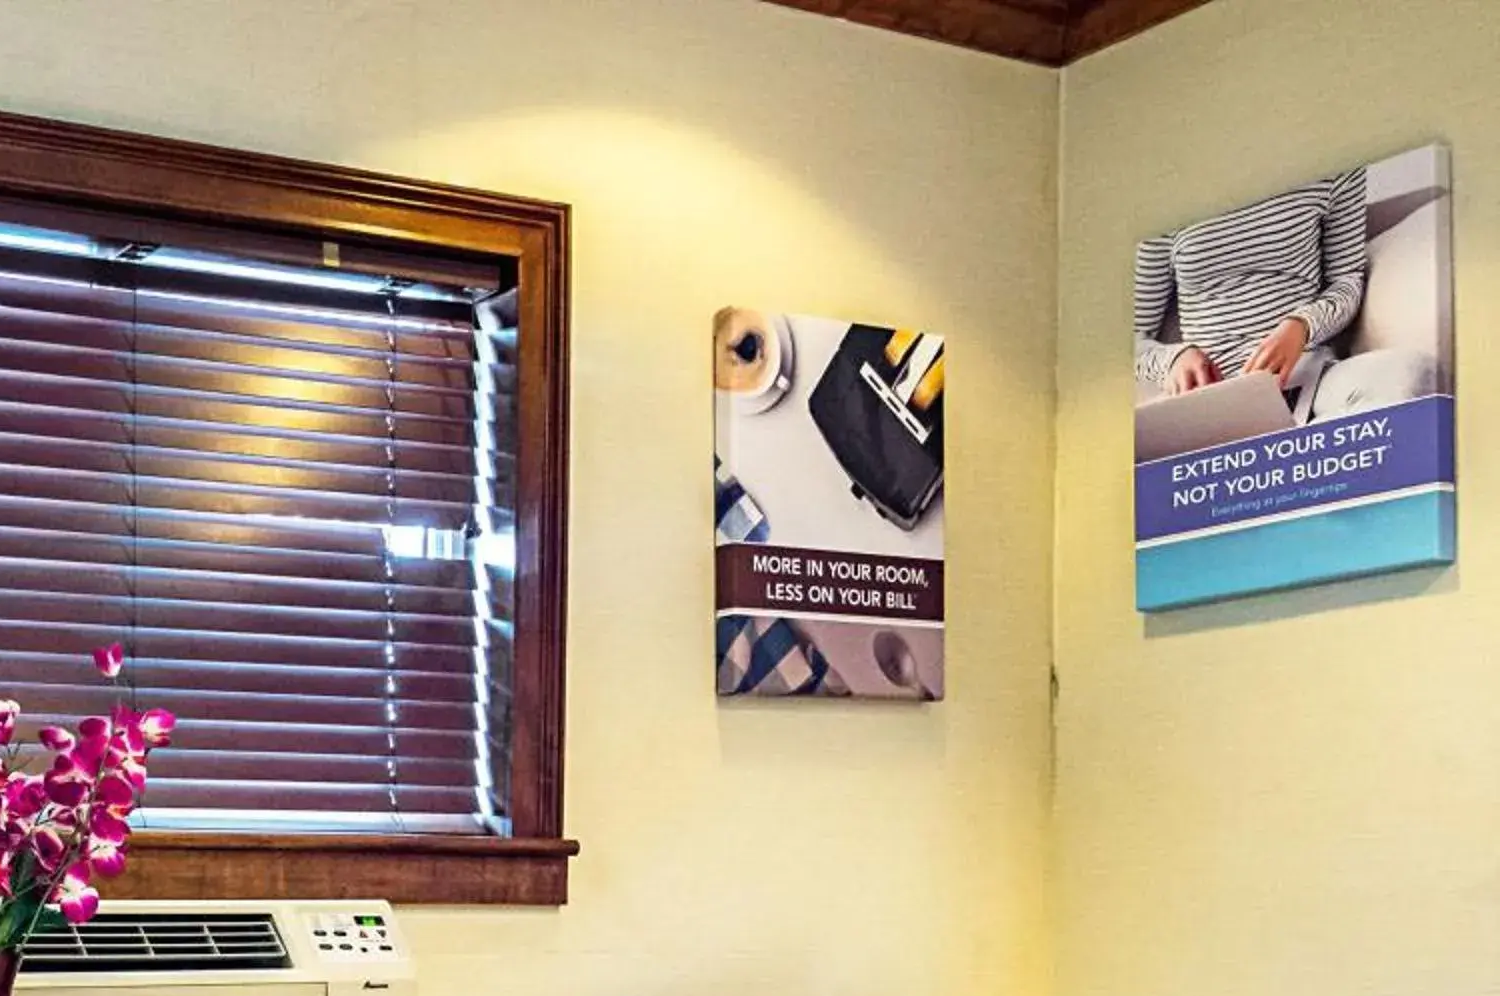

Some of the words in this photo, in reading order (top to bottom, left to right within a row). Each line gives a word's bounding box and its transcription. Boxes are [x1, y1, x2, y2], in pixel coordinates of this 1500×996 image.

[1172, 449, 1256, 482] EXTEND
[1264, 433, 1325, 461] YOUR
[1333, 417, 1392, 446] STAY,
[1173, 483, 1219, 508] NOT
[1225, 469, 1284, 496] YOUR
[1211, 499, 1261, 518] Everything
[1275, 493, 1296, 507] your
[753, 555, 801, 575] MORE
[806, 559, 823, 577] IN
[828, 561, 870, 581] YOUR
[876, 566, 929, 588] ROOM,
[766, 582, 803, 601] LESS
[808, 585, 834, 603] ON
[838, 588, 881, 607] YOUR
